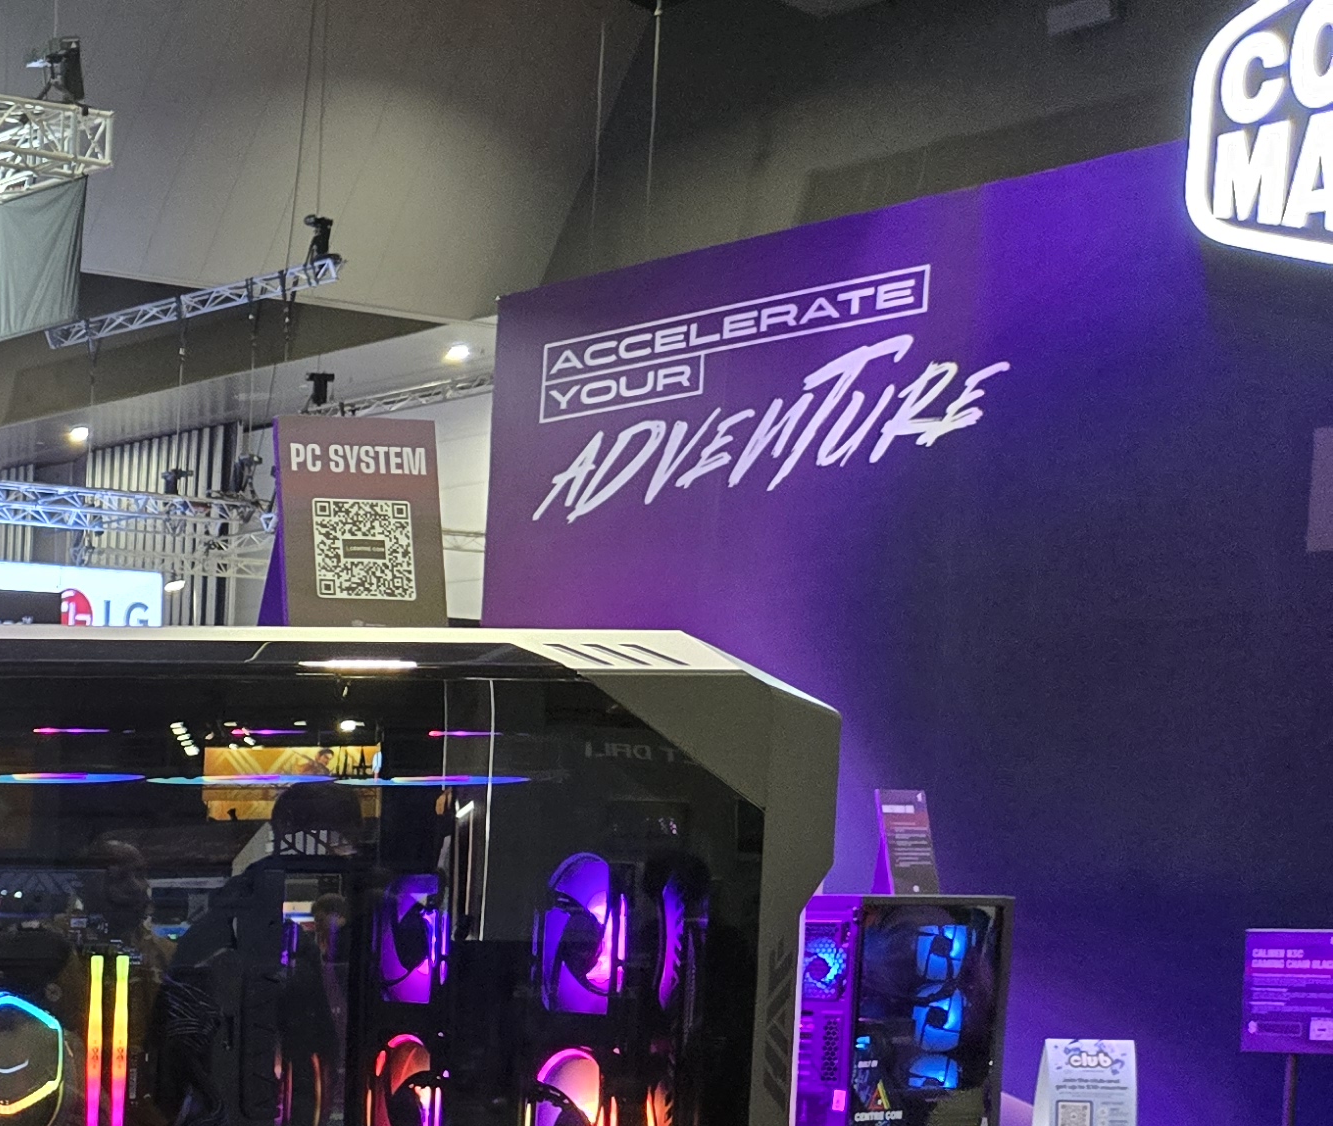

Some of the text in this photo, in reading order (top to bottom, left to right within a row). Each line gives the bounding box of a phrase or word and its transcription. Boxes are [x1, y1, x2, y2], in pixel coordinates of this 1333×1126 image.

[550, 278, 916, 374] ACCELERATE
[549, 364, 692, 411] YOUR
[533, 333, 1010, 524] ADVENTURE
[289, 441, 428, 476] PC SYSTEM
[101, 600, 149, 627] LG
[1070, 1052, 1113, 1068] club
